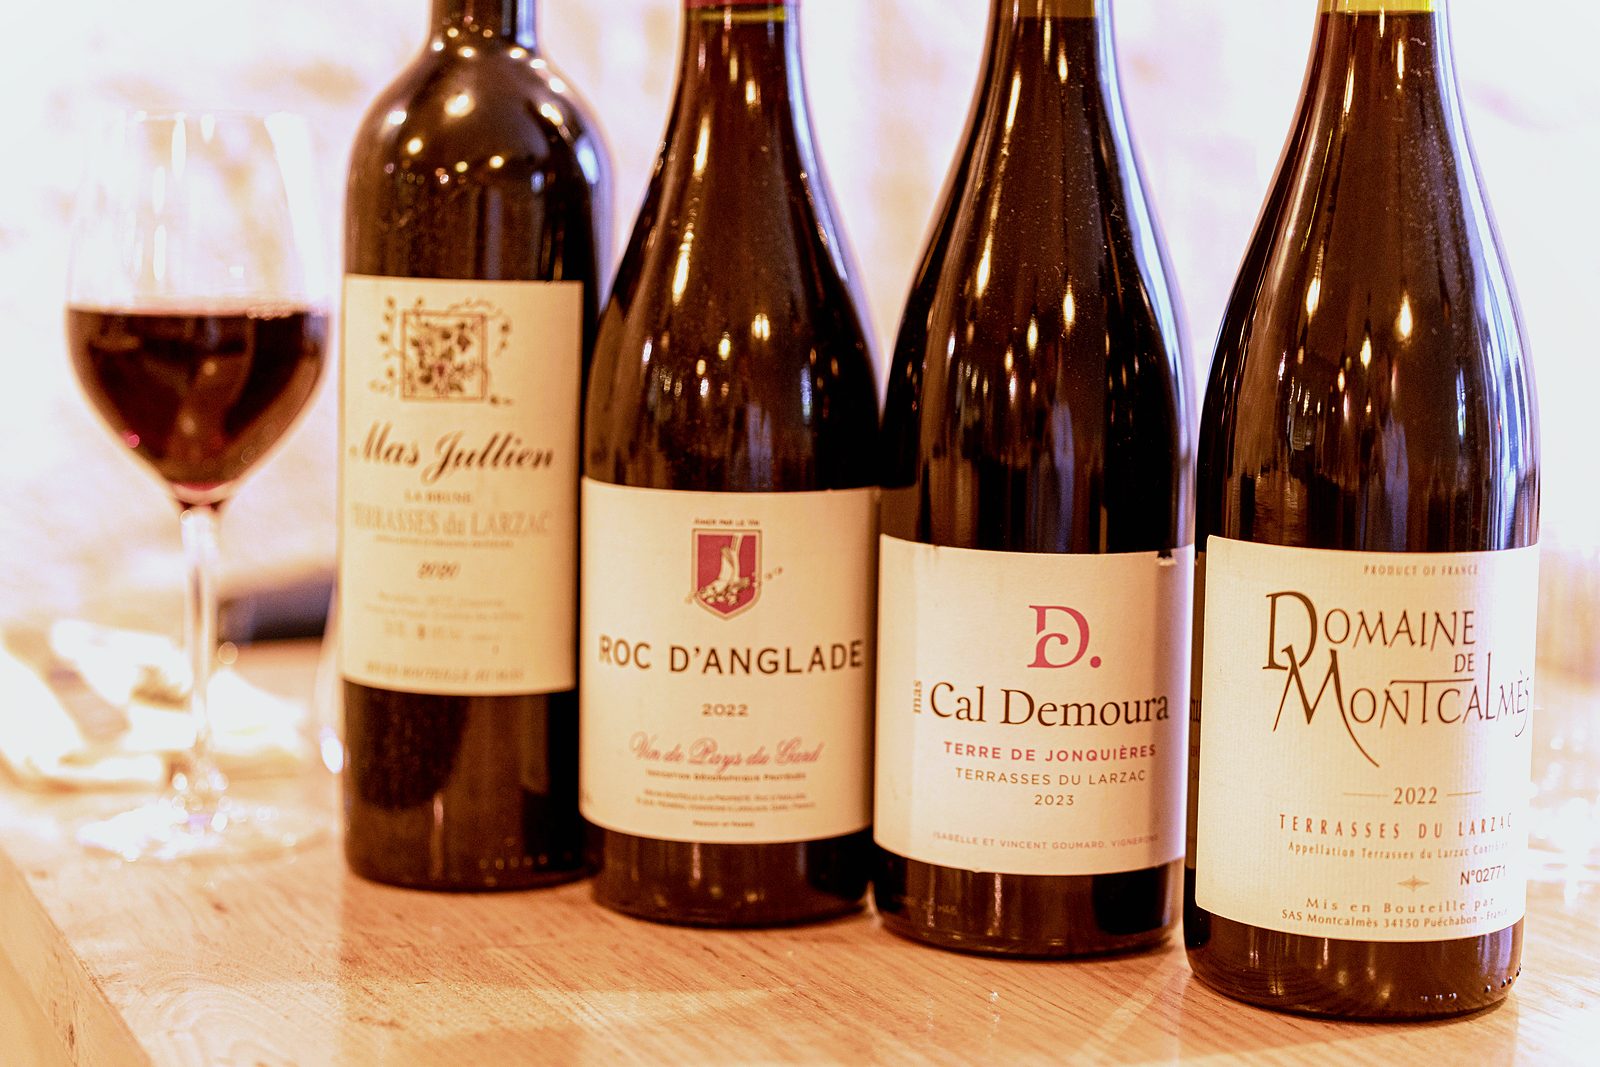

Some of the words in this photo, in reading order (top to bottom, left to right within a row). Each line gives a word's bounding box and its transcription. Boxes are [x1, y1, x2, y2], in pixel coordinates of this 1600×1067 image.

[350, 421, 420, 467] Mas
[421, 431, 554, 485] Jullien
[1363, 564, 1417, 576] PRODUCT
[1423, 565, 1436, 576] OF
[1441, 564, 1479, 576] FRANCE
[599, 634, 652, 671] ROC
[670, 639, 864, 675] D'ANGLADE
[1454, 652, 1475, 673] DE
[913, 680, 922, 715] mas
[930, 681, 987, 722] Cal
[1000, 688, 1169, 727] Demoura
[702, 703, 749, 717] 2022
[629, 731, 661, 761] Vin
[663, 744, 684, 762] de
[688, 737, 742, 775] Pays
[746, 746, 769, 765] du
[774, 736, 825, 766] Gard
[944, 741, 1001, 759] TERRE
[1011, 748, 1036, 761] DE
[1045, 742, 1157, 762] JONQUIÈRES
[955, 767, 1051, 785] TERRASSES
[1059, 774, 1081, 785] DU
[1088, 769, 1146, 785] LARZAC
[1034, 794, 1074, 806] 2023
[1393, 787, 1437, 804] 2022
[1280, 814, 1400, 839] TERRASSES
[1418, 822, 1443, 838] DU
[1458, 812, 1512, 837] LARZAC
[932, 831, 978, 845] ISABELLE
[982, 838, 995, 846] ET
[999, 839, 1047, 849] VINCENT
[1288, 841, 1355, 857] Appellation
[1361, 848, 1414, 860] Terrasses
[1420, 849, 1432, 860] du
[1437, 848, 1469, 859] Larzac
[1460, 865, 1506, 886] N°02771
[1306, 898, 1338, 911] Mis
[1350, 904, 1371, 913] en
[1384, 899, 1466, 913] Bouteille
[1474, 898, 1494, 912] par
[1282, 909, 1302, 920] SAS
[1307, 913, 1378, 928] Montcalmès
[1384, 918, 1419, 928] 34150
[1424, 914, 1477, 927] Puéchabon
